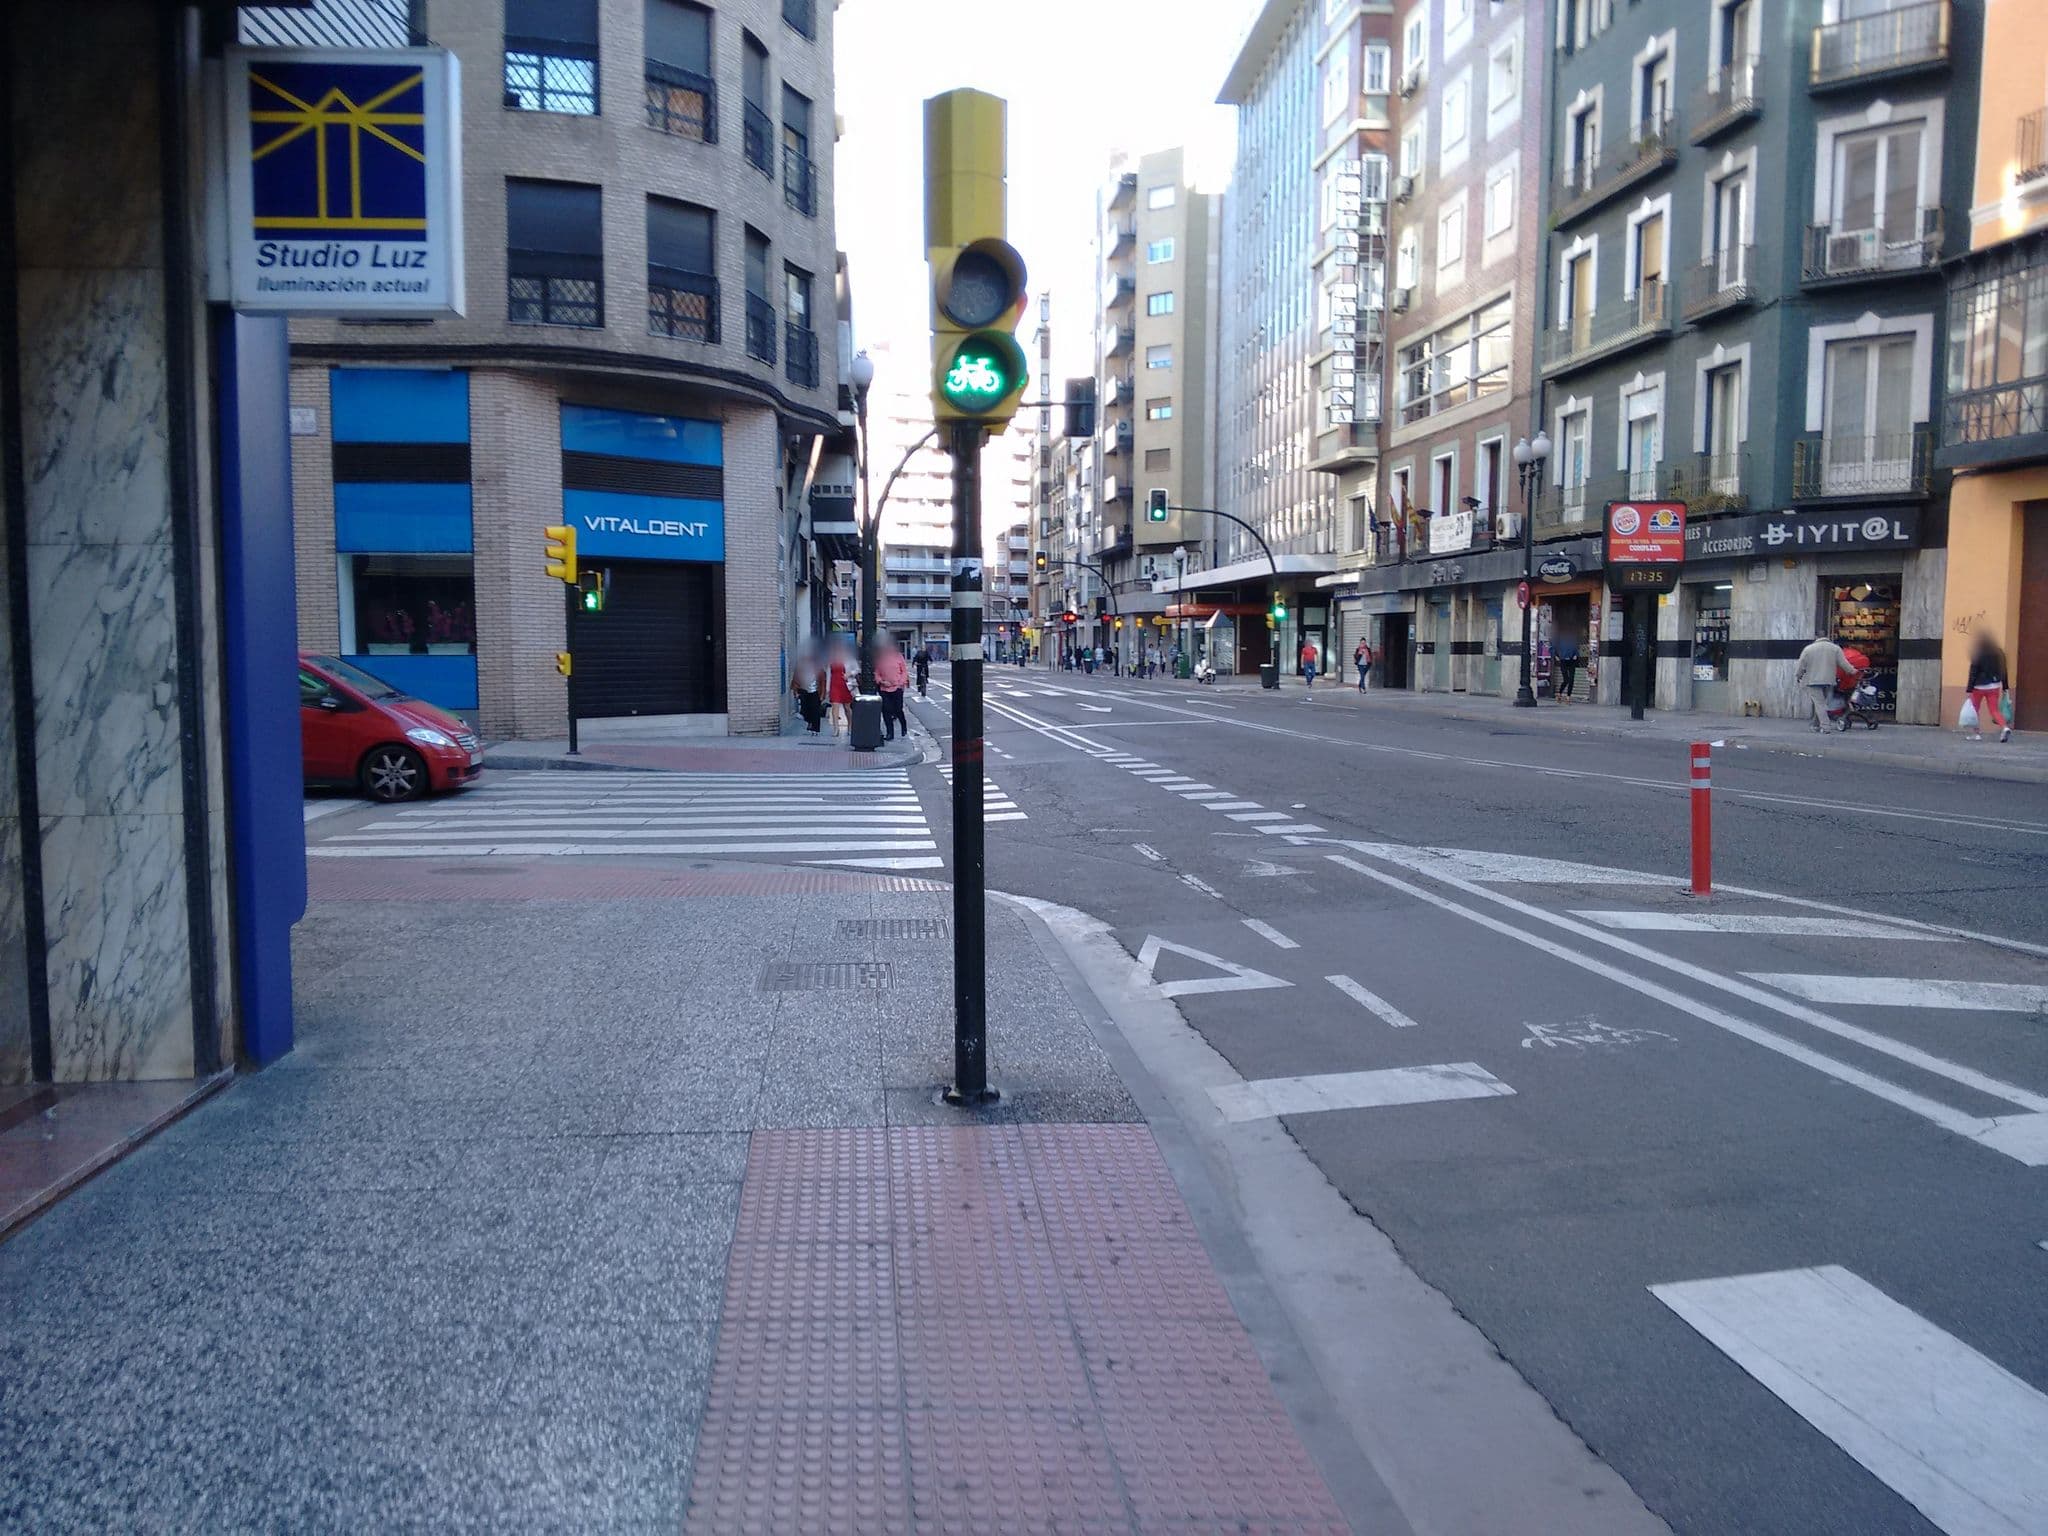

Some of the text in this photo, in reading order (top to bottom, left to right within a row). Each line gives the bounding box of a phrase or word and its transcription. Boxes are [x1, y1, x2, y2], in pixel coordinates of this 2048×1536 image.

[256, 242, 427, 268] Studio Luz
[256, 276, 430, 292] Iluminación actual
[584, 515, 709, 537] VITALDENT
[1685, 527, 1701, 541] ILES
[1705, 526, 1712, 538] Y
[1702, 536, 1753, 554] ACCESORIOS
[1630, 571, 1663, 582] 17:35
